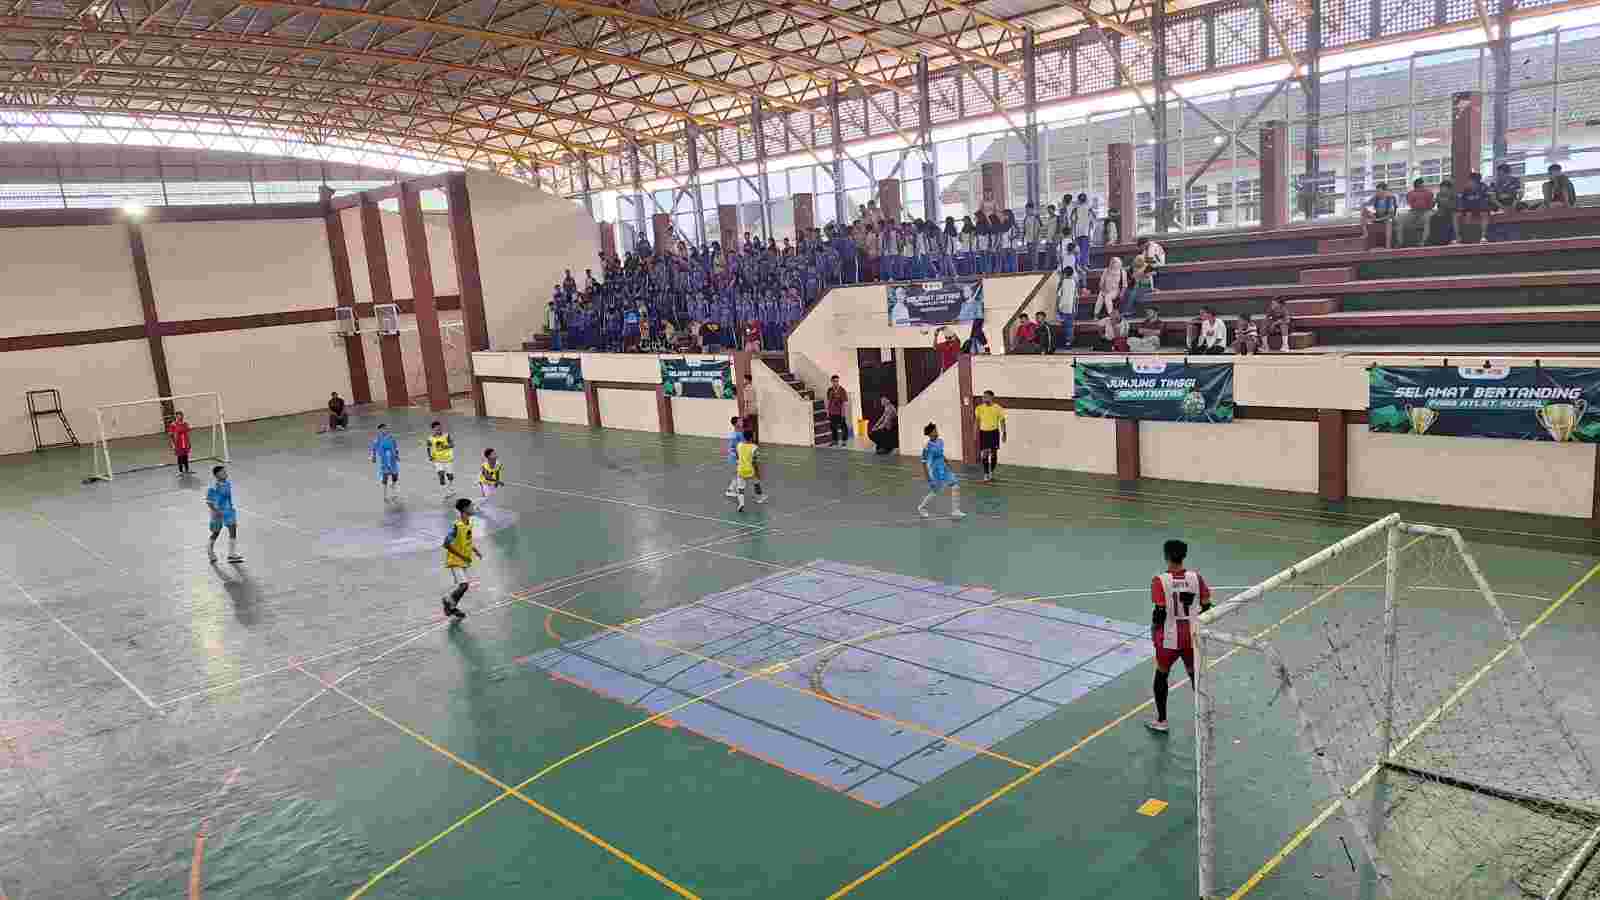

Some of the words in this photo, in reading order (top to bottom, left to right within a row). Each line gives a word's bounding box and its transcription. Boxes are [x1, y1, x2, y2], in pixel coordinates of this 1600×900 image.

[1106, 378, 1156, 388] JUNJUNG
[1160, 378, 1197, 388] TINGGI
[1394, 386, 1468, 399] SELAMAT
[1473, 386, 1584, 400] BERTANDING
[1172, 591, 1196, 617] 17
